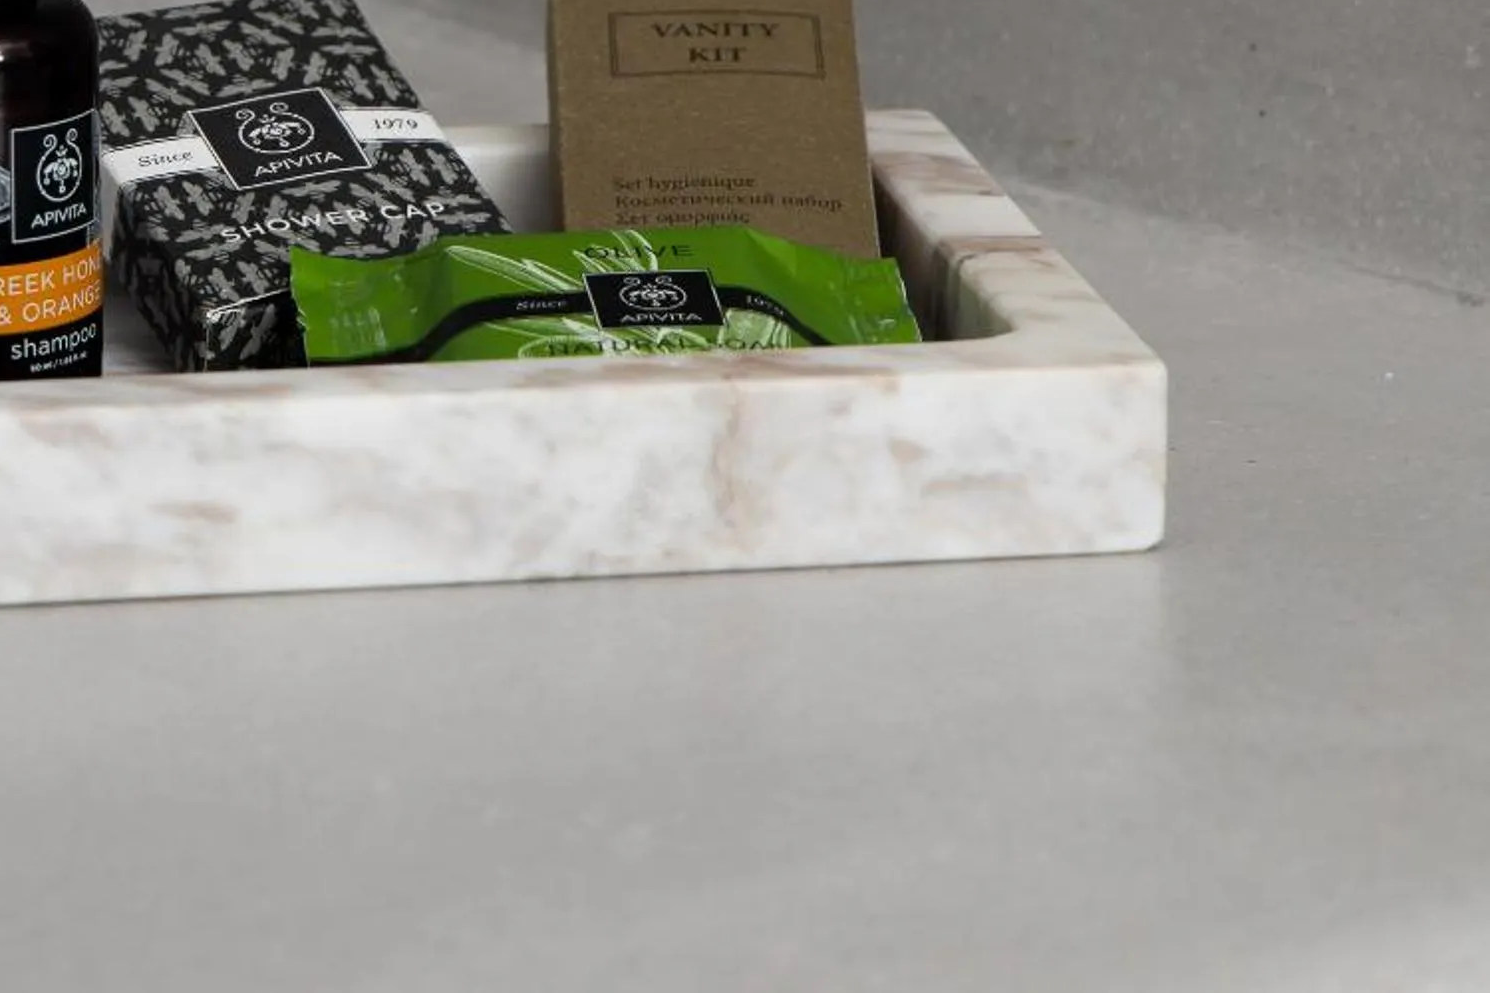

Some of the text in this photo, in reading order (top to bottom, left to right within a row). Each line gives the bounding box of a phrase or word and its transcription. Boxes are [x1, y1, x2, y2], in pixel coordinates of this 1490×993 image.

[651, 21, 780, 39] VANITY
[688, 47, 748, 64] KIT
[370, 117, 420, 132] 1979
[137, 150, 195, 169] Since
[254, 150, 345, 178] APIVITA
[614, 177, 644, 191] Set
[31, 202, 88, 229] APIVITA
[221, 202, 446, 245] SHOWER CAP
[584, 244, 694, 259] OLIVE
[63, 250, 101, 285] HON
[21, 279, 101, 324] ORANGE
[620, 312, 703, 323] APIVITA
[10, 322, 97, 361] shampoo
